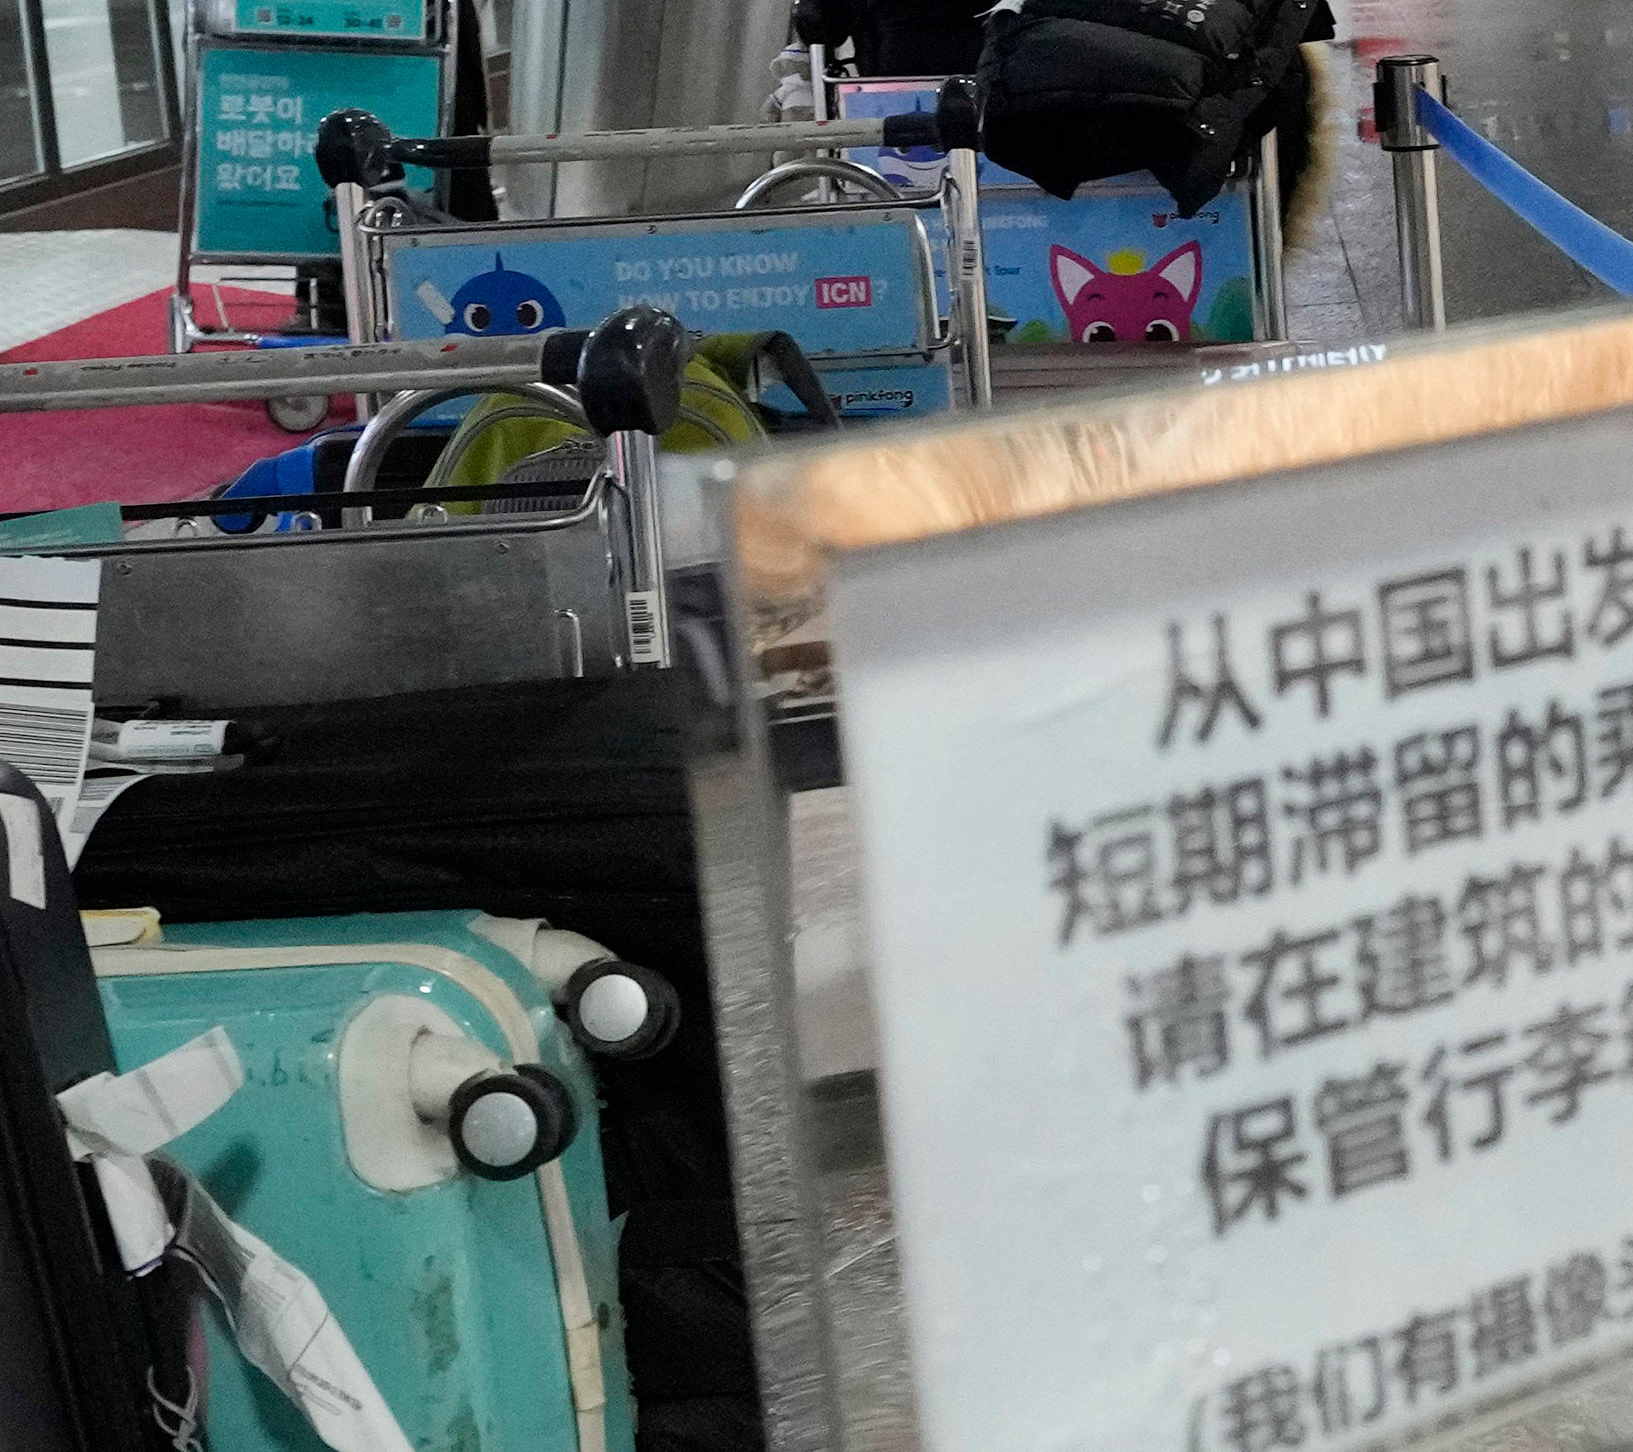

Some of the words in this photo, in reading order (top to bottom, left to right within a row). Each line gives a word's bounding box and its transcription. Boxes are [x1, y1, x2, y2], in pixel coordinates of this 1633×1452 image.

[615, 259, 652, 283] DO
[660, 255, 714, 281] YOU
[718, 251, 800, 277] KNOW
[684, 288, 717, 312] TO
[726, 284, 812, 310] ENJOY
[820, 280, 868, 305] ICN
[845, 388, 914, 409] pinkfong
